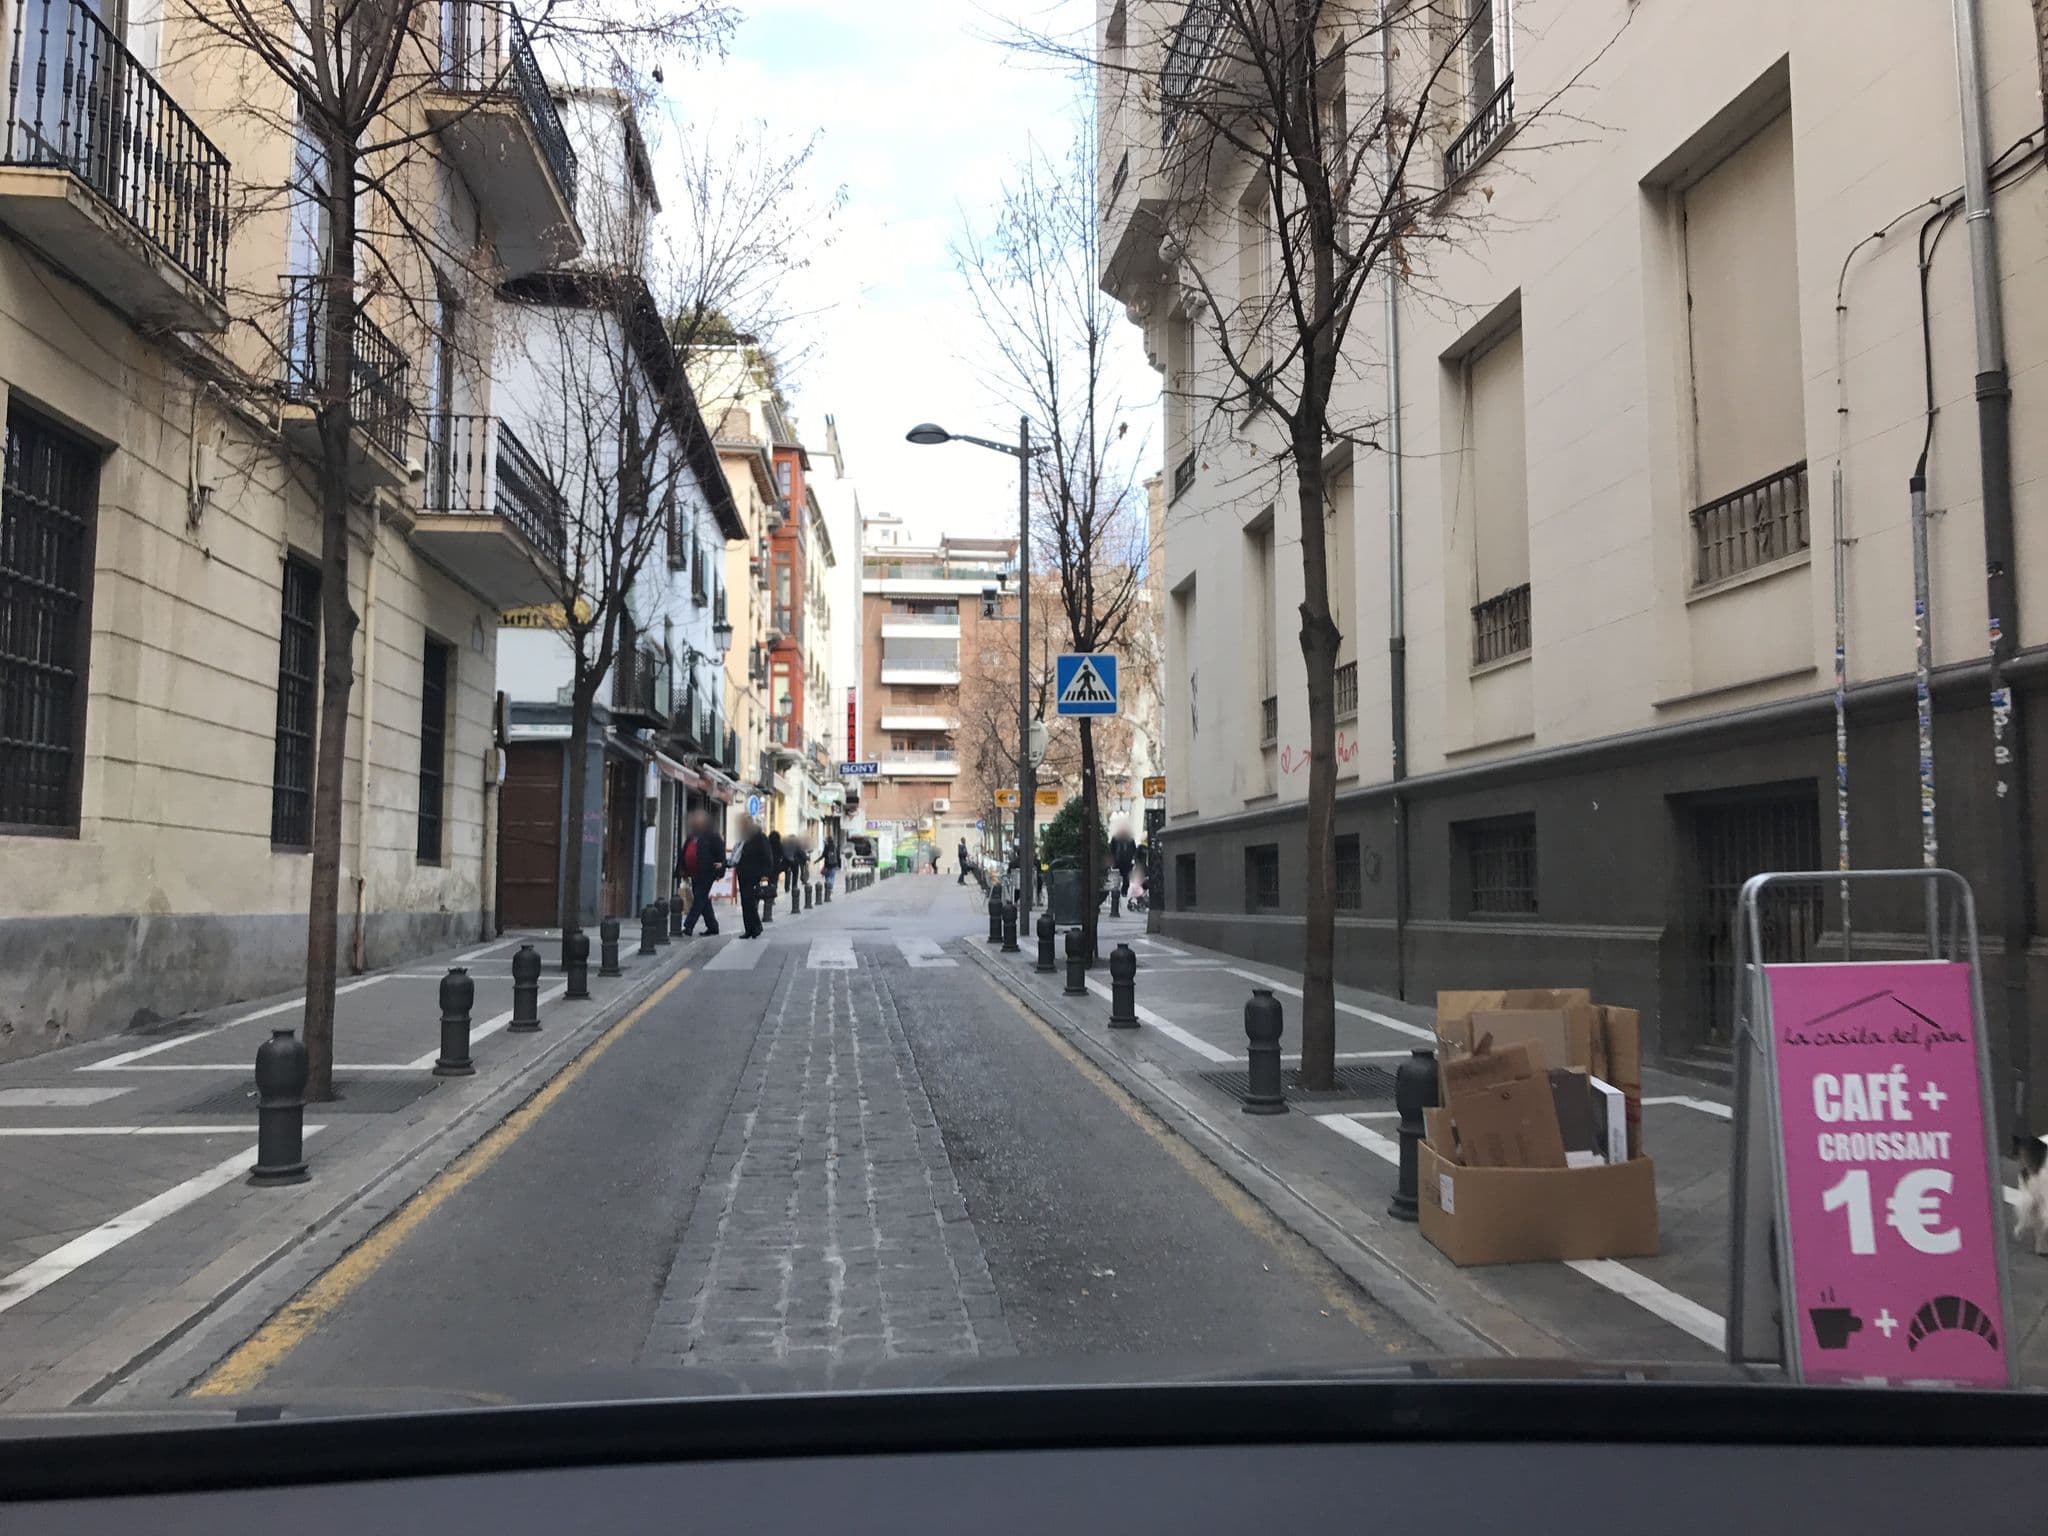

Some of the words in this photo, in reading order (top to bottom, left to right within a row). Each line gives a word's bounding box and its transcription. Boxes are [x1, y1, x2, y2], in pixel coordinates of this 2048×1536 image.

[842, 764, 876, 774] SONY
[1888, 1023, 1921, 1045] del
[1812, 1063, 1913, 1122] CAFÉ
[1918, 1081, 1948, 1111] +
[1818, 1132, 1951, 1162] CROISSANT
[1822, 1168, 1962, 1255] 1€
